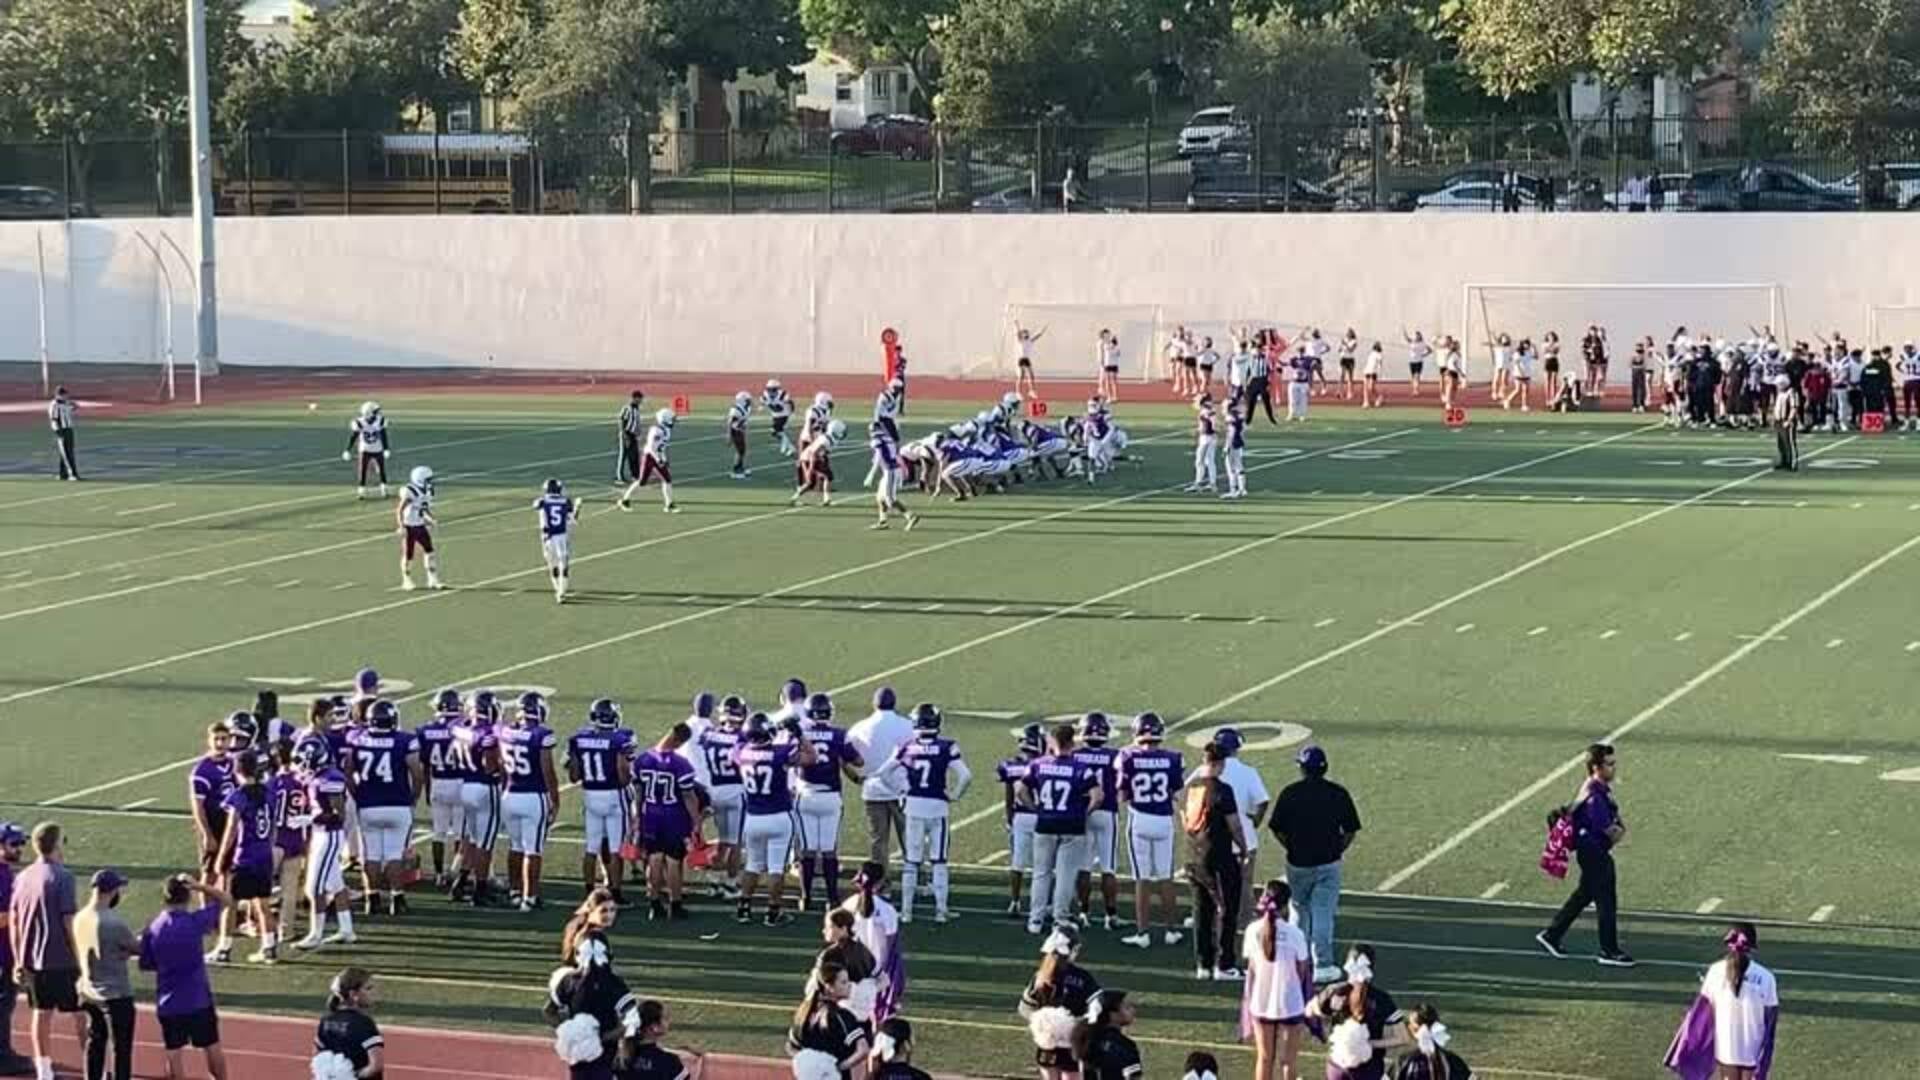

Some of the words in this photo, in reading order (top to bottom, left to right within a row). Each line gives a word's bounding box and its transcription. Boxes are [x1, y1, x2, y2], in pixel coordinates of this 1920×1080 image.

[550, 506, 563, 526] 5
[358, 751, 393, 782] 74
[502, 744, 531, 775] 55
[581, 752, 607, 782] 11
[707, 747, 736, 776] 12
[914, 760, 931, 788] 7
[639, 769, 677, 804] 77
[741, 765, 773, 794] 67
[1131, 773, 1169, 803] 23
[1040, 780, 1071, 811] 47
